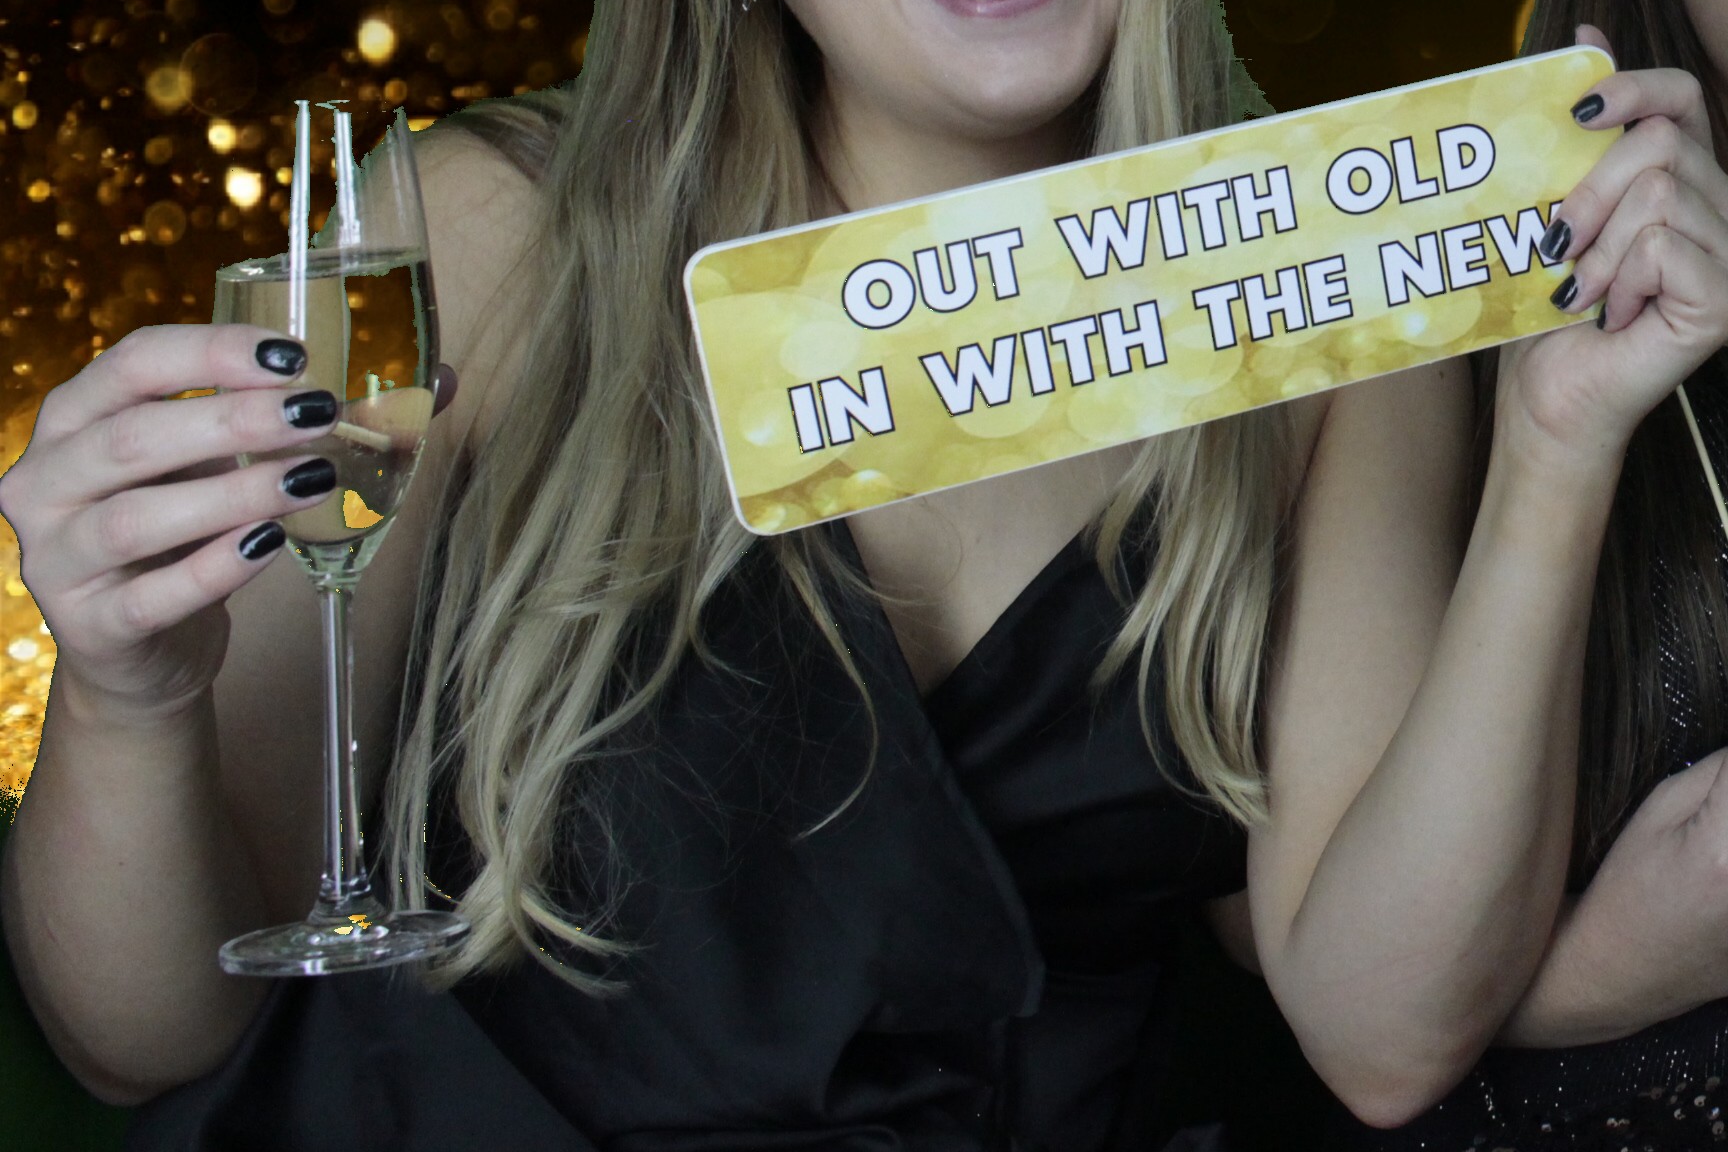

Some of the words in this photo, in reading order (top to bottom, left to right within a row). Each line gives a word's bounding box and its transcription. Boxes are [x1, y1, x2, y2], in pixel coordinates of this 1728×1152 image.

[786, 369, 895, 454] IN
[919, 300, 1168, 418] WITH
[1193, 254, 1354, 352] THE
[1379, 200, 1564, 310] NEW
[841, 228, 1024, 330] OUT
[1056, 166, 1297, 280] WITH
[1326, 123, 1496, 216] OLD
